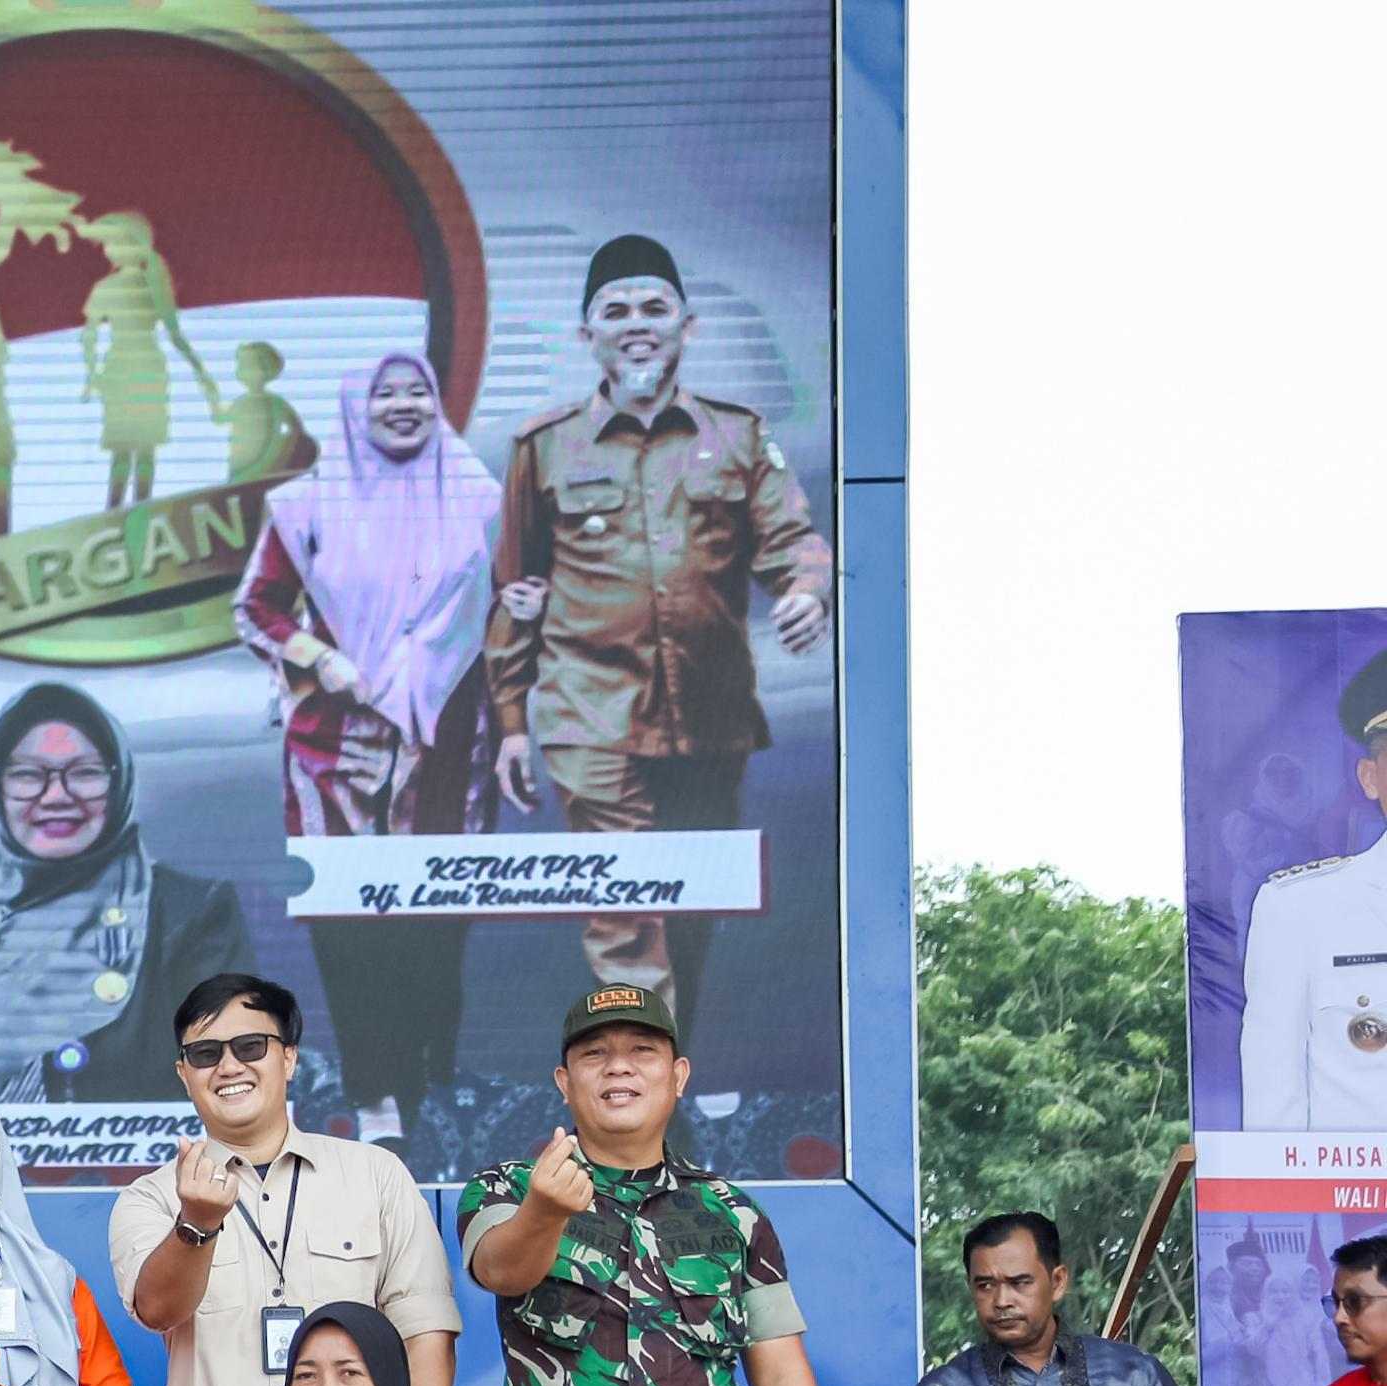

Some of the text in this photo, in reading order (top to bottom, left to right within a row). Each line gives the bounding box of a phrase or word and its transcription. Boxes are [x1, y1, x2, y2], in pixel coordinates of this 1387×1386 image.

[425, 853, 618, 881] KETUA PKK
[360, 884, 403, 914] Hj.
[408, 884, 473, 909] Leni
[0, 1117, 105, 1138] KEPALA
[1284, 1146, 1384, 1167] H. PAISA
[1333, 1186, 1380, 1209] WALI
